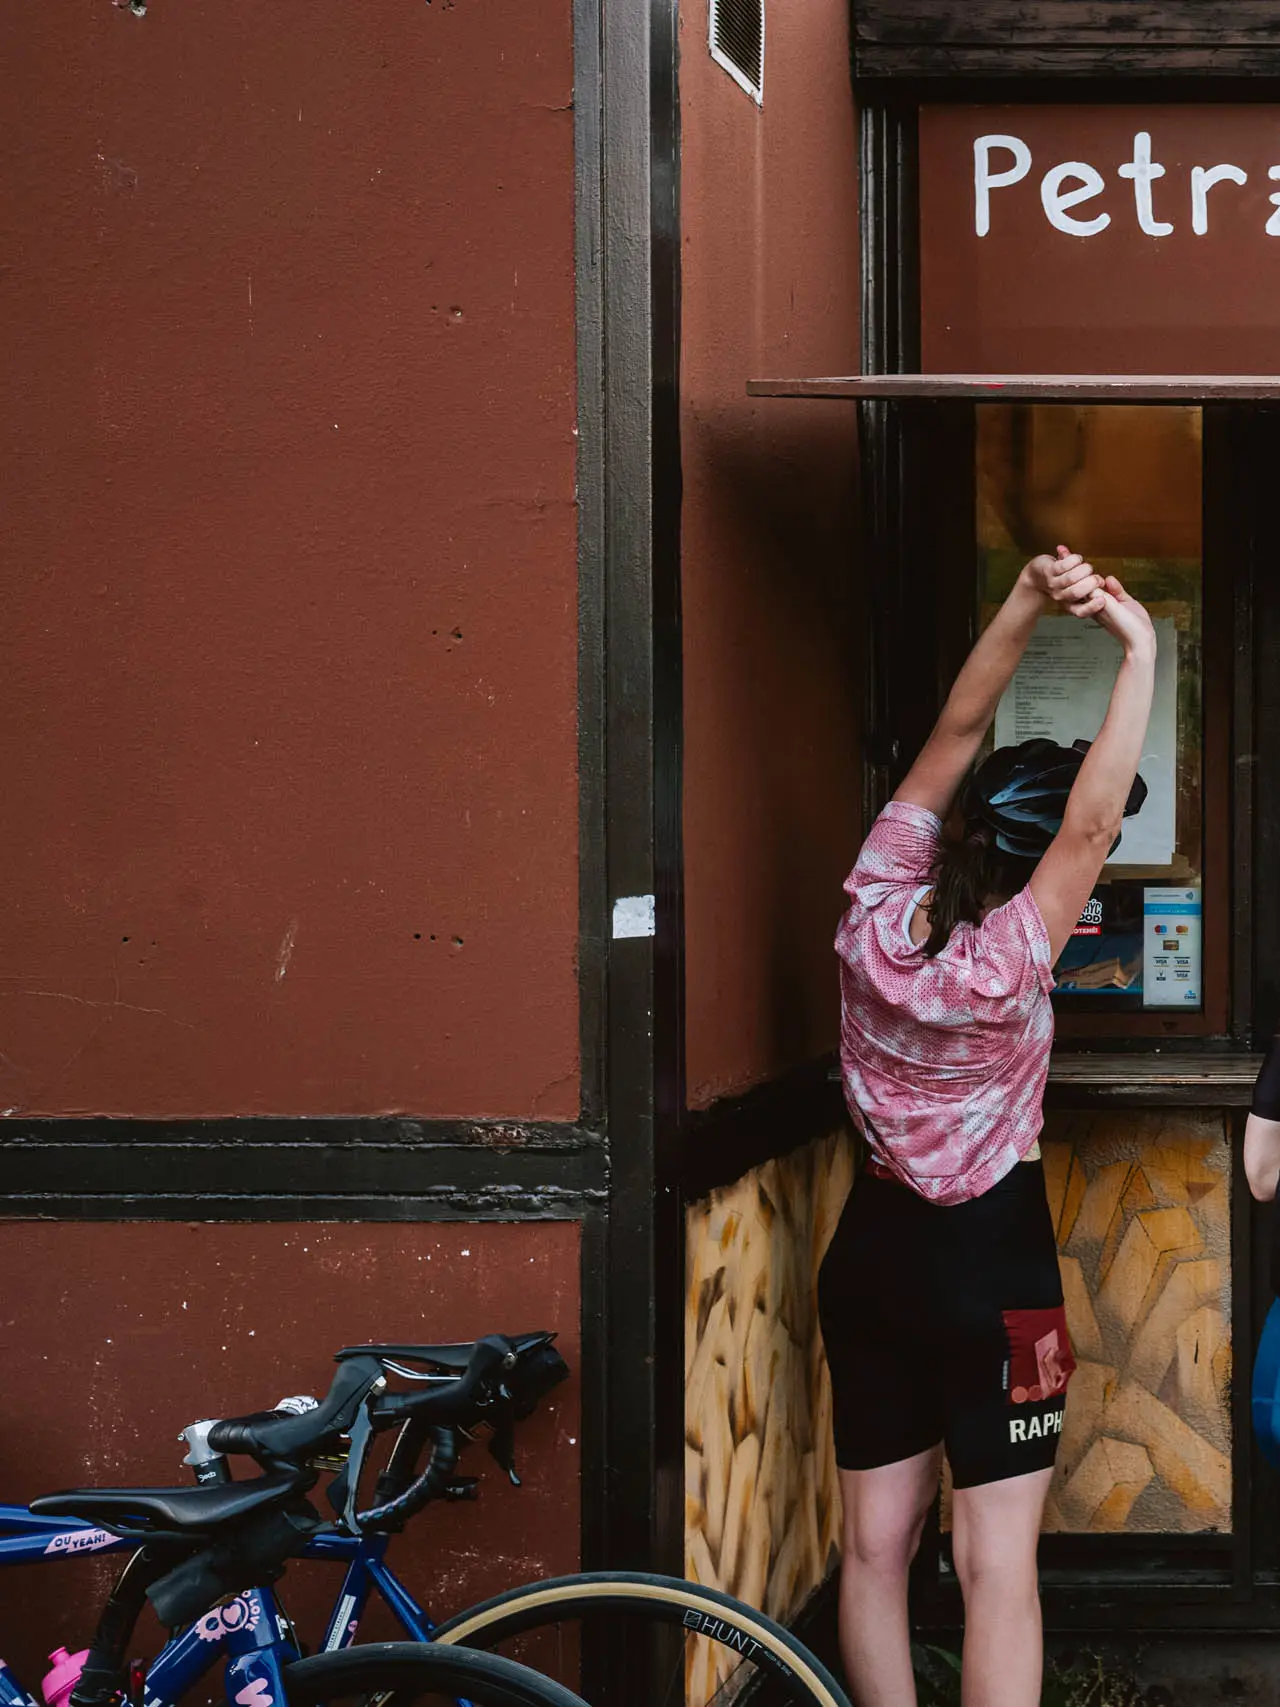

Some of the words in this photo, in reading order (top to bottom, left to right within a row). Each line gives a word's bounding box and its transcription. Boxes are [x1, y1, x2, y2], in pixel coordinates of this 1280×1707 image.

[1009, 1409, 1066, 1443] RAPH
[54, 1536, 72, 1548] OU
[72, 1533, 107, 1549] YEAH!
[244, 1598, 261, 1632] LOVE
[700, 1616, 764, 1658] HUNT
